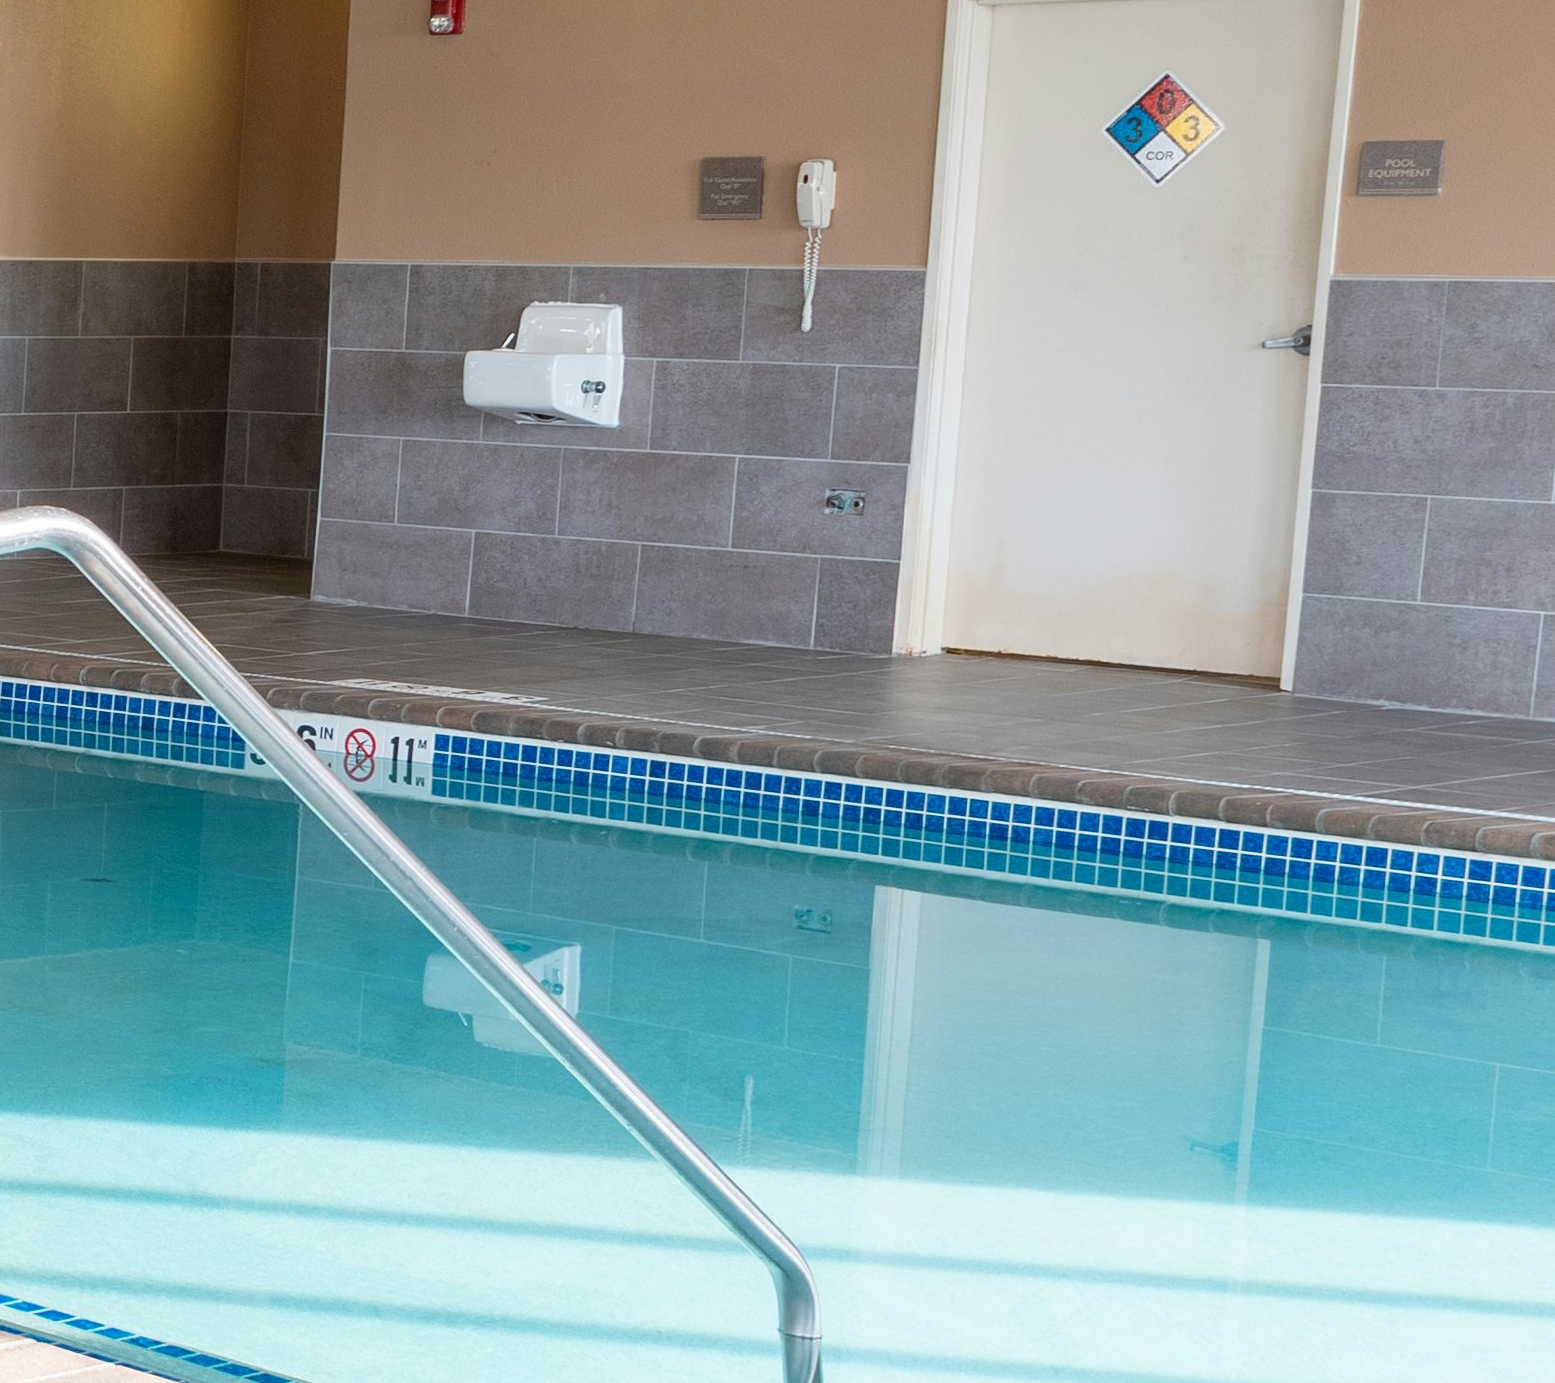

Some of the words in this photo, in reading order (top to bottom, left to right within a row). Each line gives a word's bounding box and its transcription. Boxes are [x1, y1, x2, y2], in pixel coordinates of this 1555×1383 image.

[1157, 89, 1175, 115] 0
[1125, 116, 1143, 143] 3
[1182, 115, 1201, 142] 3
[1146, 151, 1174, 161] COR
[1385, 159, 1415, 168] POOL
[1368, 168, 1432, 178] EQUIPMENT
[319, 727, 334, 741] IN
